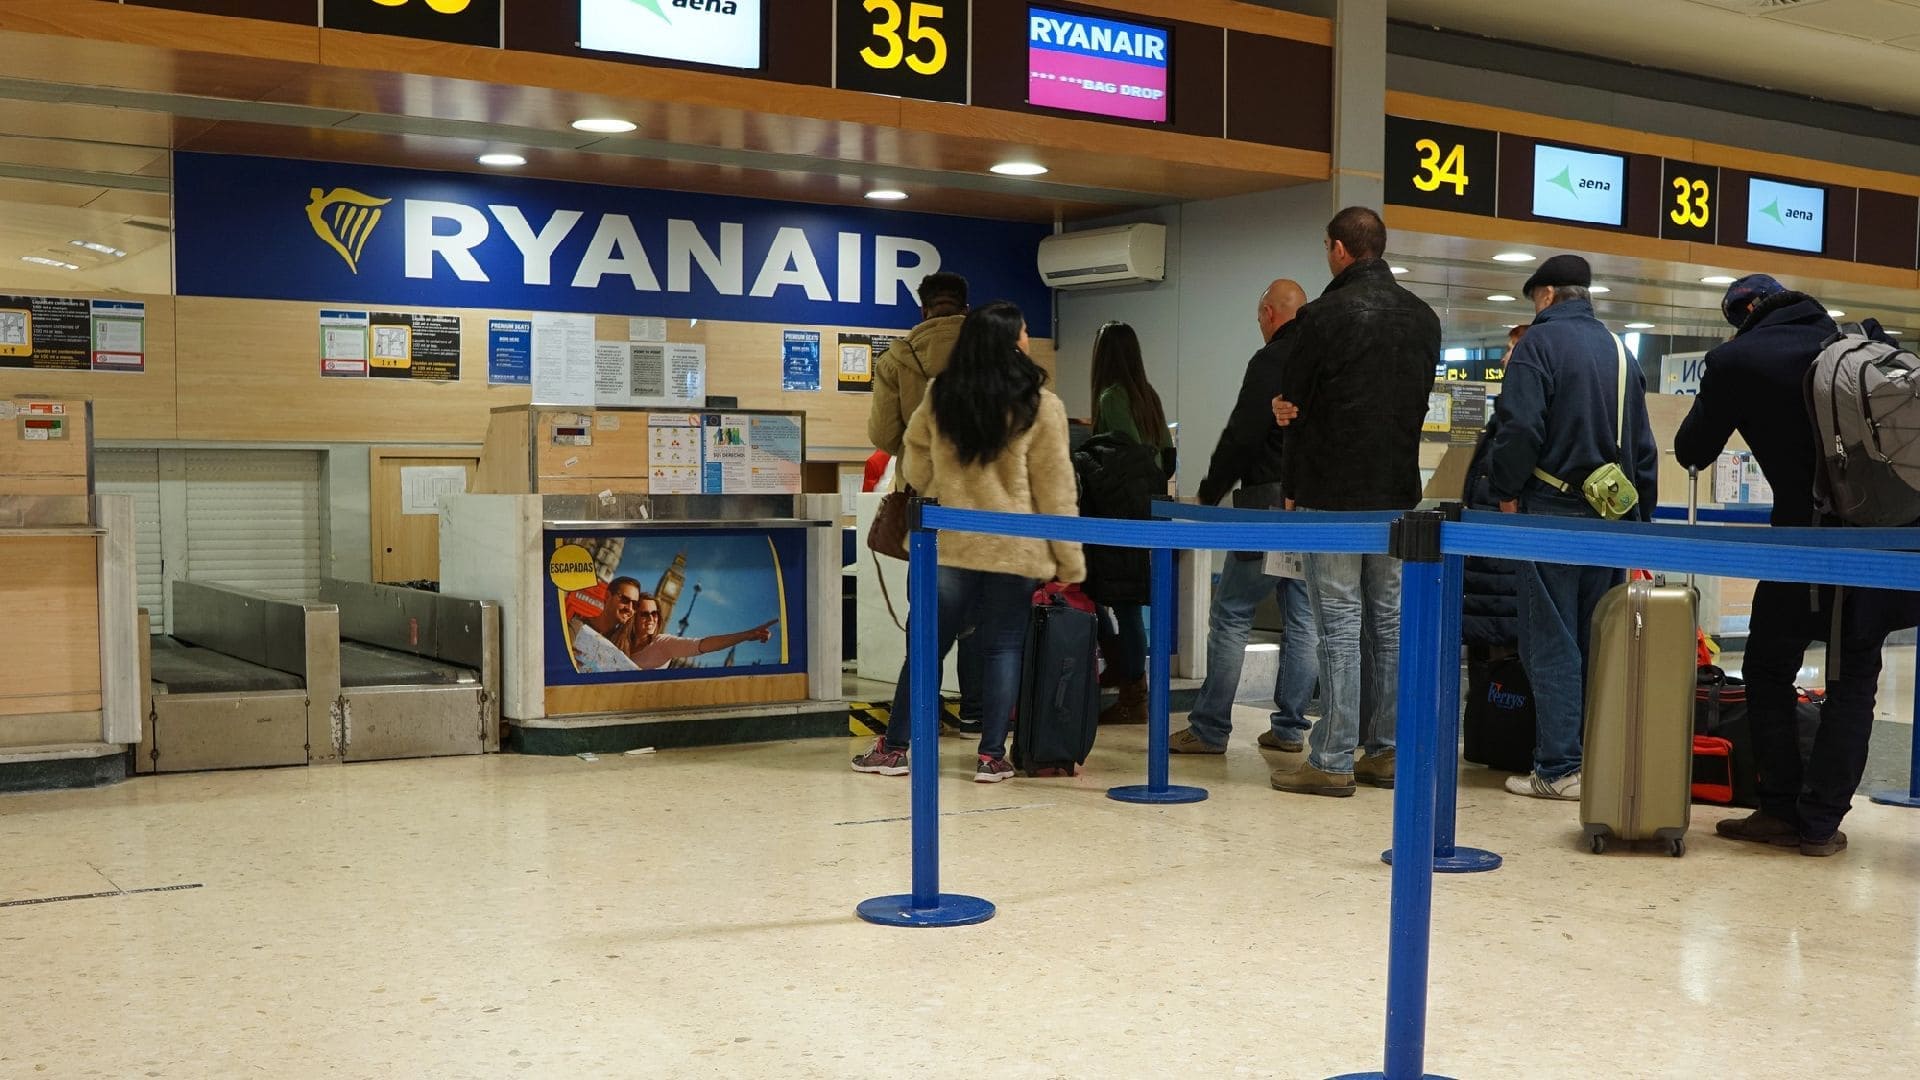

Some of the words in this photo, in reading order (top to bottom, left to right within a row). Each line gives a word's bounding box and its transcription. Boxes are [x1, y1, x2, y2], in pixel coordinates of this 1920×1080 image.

[859, 0, 947, 75] 35
[1029, 16, 1165, 61] RYANAIR
[1119, 84, 1165, 100] DROP
[1412, 138, 1469, 196] 34
[1578, 176, 1611, 192] aena
[1670, 176, 1710, 228] 33
[1785, 206, 1813, 221] aena
[404, 198, 942, 307] RYANAIR
[550, 562, 593, 574] ESCAPADAS
